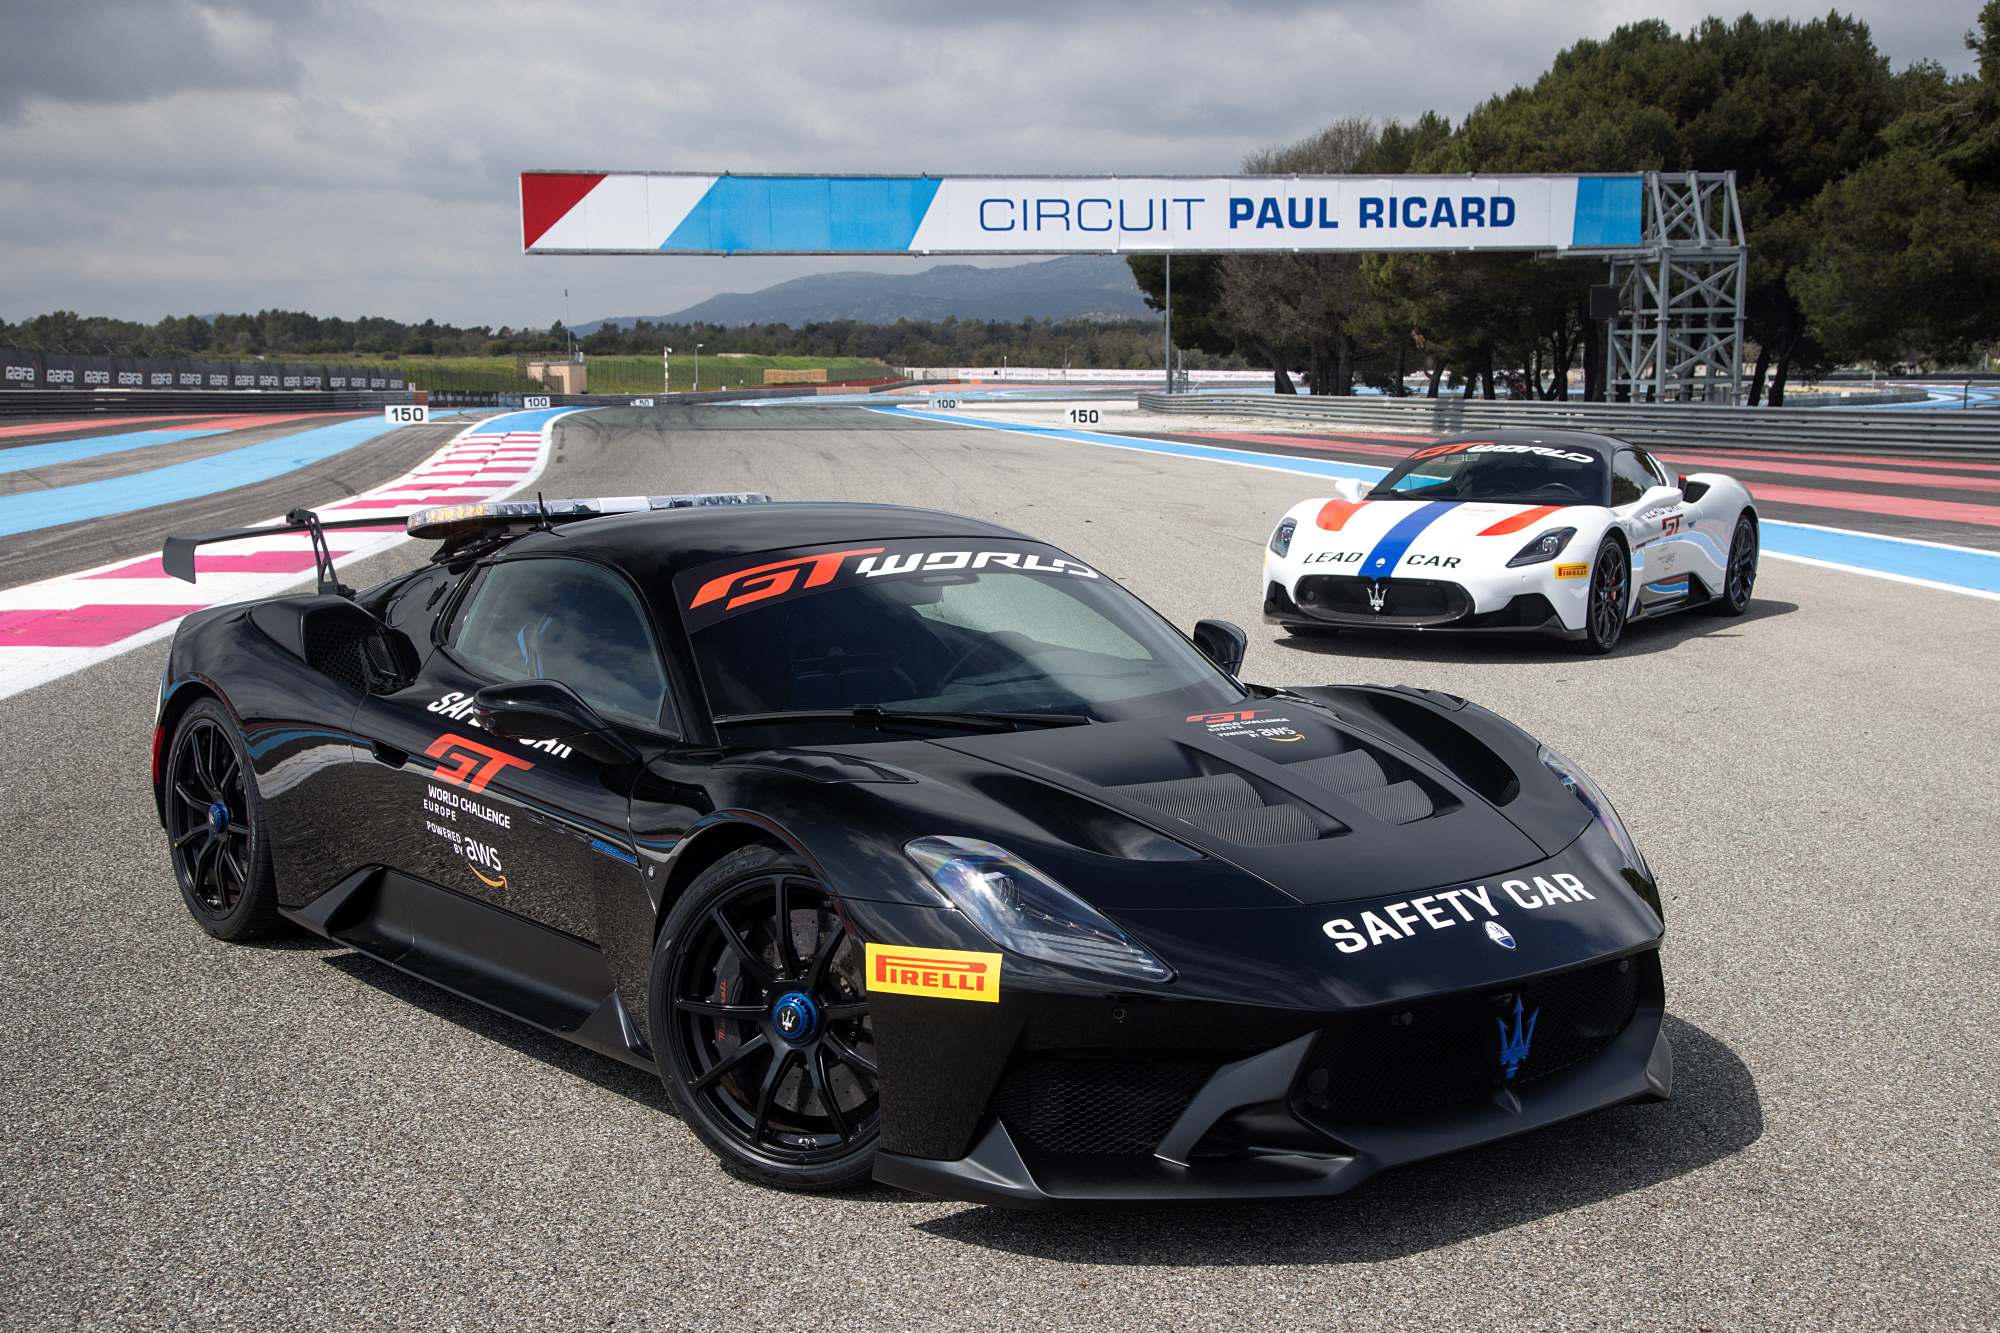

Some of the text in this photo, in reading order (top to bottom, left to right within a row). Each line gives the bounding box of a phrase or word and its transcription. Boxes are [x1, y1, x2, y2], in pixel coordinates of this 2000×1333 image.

[979, 196, 1516, 232] CIRCUIT PAUL RICARD
[528, 398, 547, 407] 100
[936, 400, 956, 409] 100
[391, 407, 424, 422] 150
[1070, 410, 1099, 423] 150
[1408, 441, 1595, 464] GT WORLD
[1303, 552, 1462, 569] LEAD CAR
[1558, 565, 1587, 577] PIRELLI
[689, 547, 1100, 610] GT WORLD
[1185, 709, 1272, 724] GT
[1257, 727, 1296, 736] aws
[424, 733, 536, 794] GT
[423, 799, 456, 821] EUROPE
[428, 784, 511, 829] WORLD CHALLENGE
[426, 821, 461, 844] POWERED
[453, 843, 463, 855] BY
[465, 837, 502, 871] aws
[1322, 873, 1598, 954] SAFETY CAR
[876, 955, 988, 992] PIRELLI
